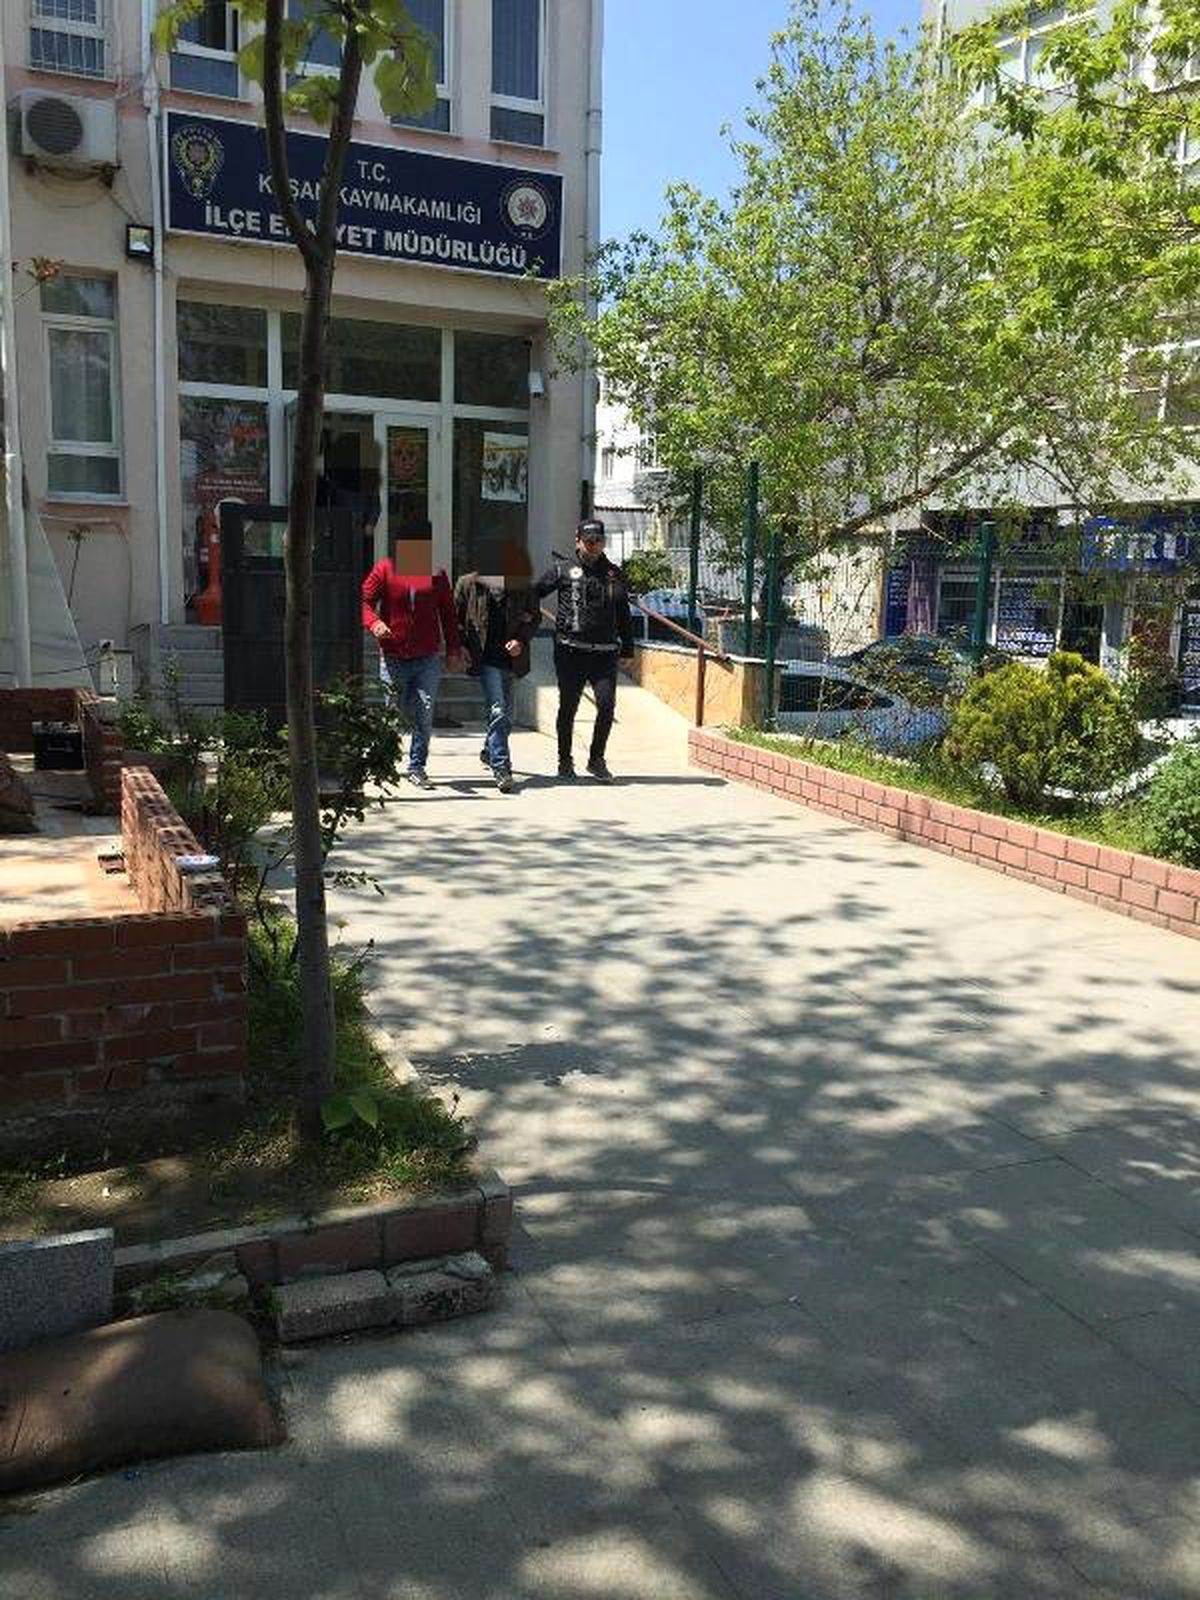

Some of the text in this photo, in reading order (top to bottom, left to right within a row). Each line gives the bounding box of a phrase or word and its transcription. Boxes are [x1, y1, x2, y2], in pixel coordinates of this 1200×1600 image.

[357, 160, 391, 184] T.C.
[257, 173, 321, 201] KŞA
[204, 200, 261, 235] İLÇE
[383, 229, 528, 268] MÜDÜRLÜĞÜ
